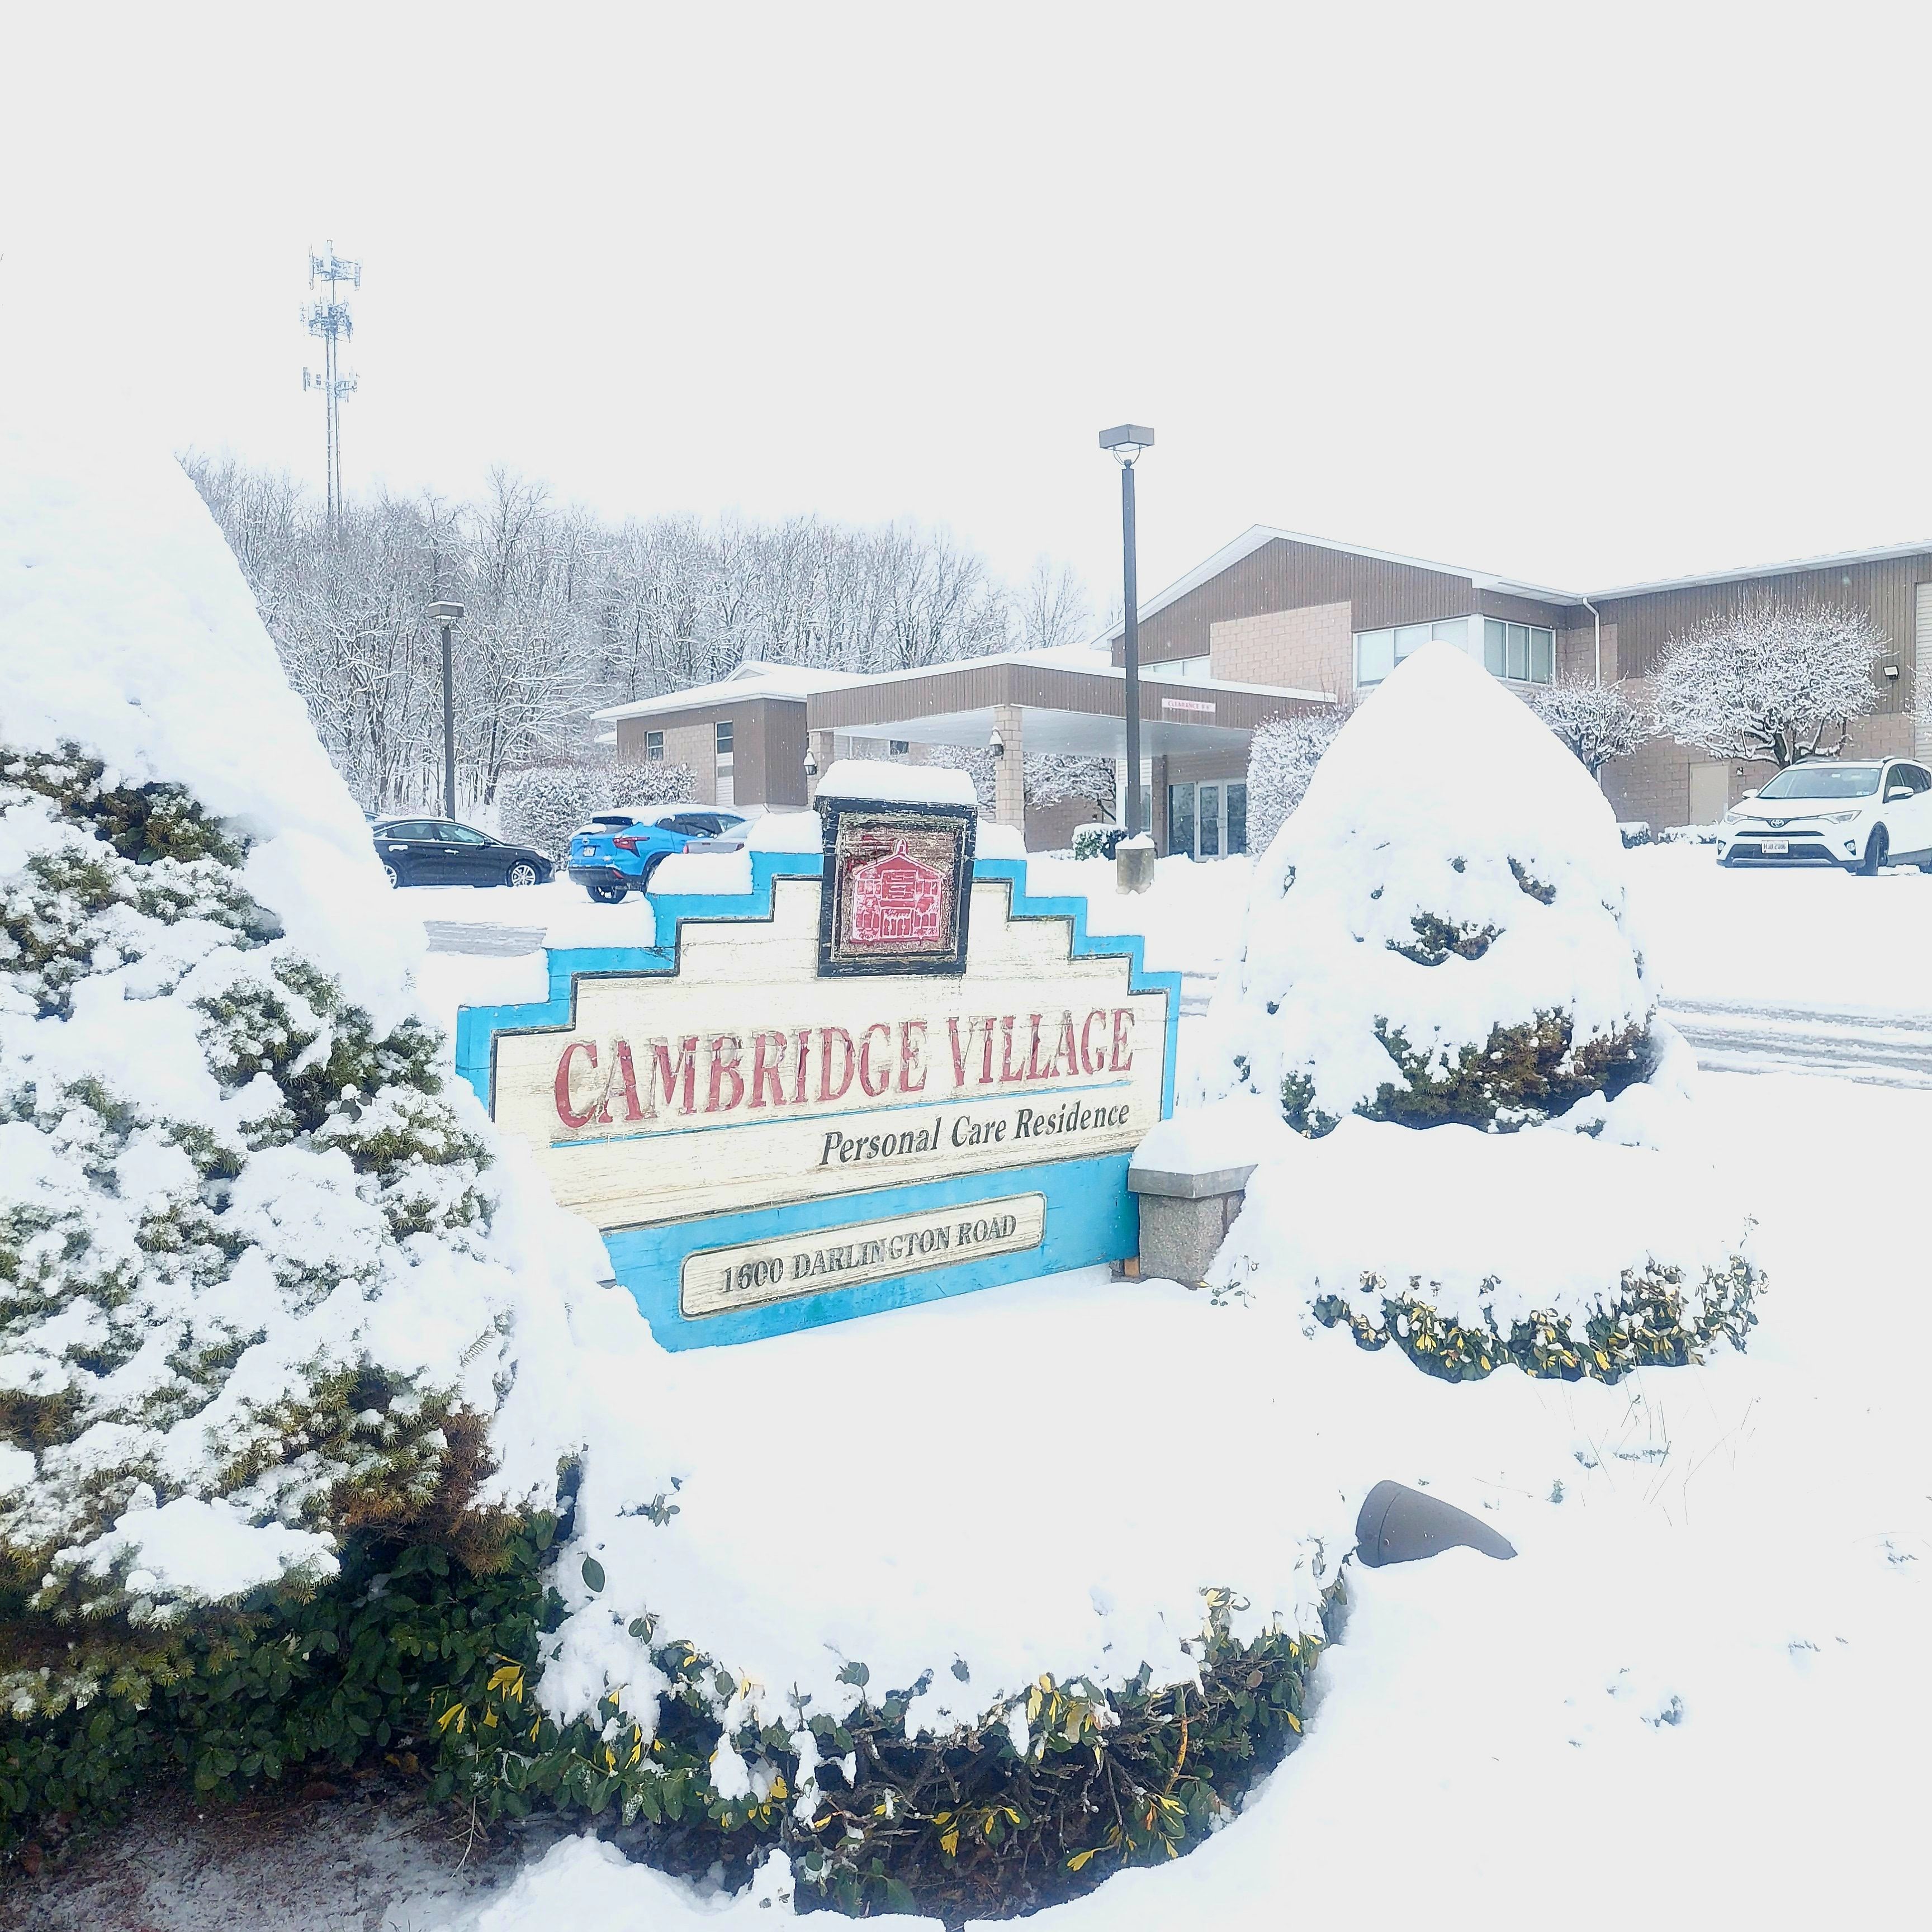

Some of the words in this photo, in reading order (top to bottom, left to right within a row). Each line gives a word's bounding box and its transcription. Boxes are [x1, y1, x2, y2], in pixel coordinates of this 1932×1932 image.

[555, 1020, 929, 1128] CAMBRIDGE
[948, 1007, 1135, 1086] VILLAGE
[819, 1117, 941, 1166] Personal
[951, 1115, 1007, 1148] Care
[1014, 1101, 1130, 1139] Residence
[722, 1257, 784, 1293] 1600
[793, 1225, 951, 1280] DARLINGTON
[958, 1214, 1017, 1246] ROAD
